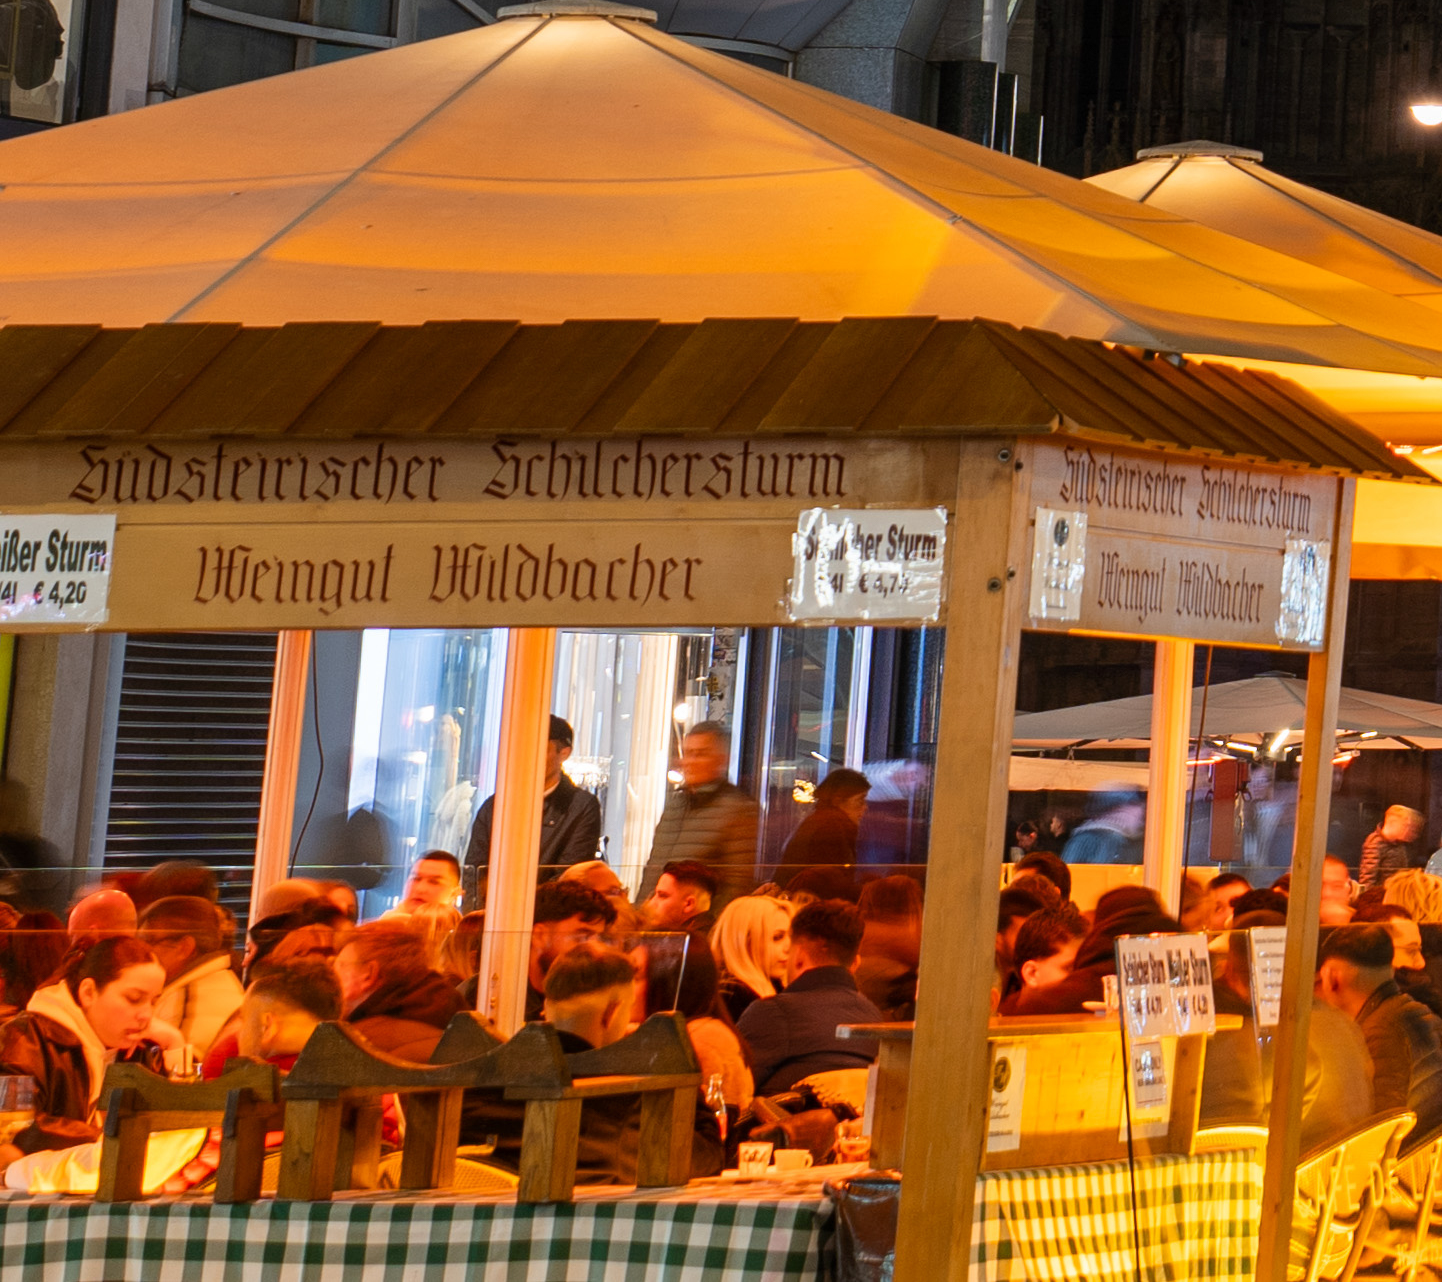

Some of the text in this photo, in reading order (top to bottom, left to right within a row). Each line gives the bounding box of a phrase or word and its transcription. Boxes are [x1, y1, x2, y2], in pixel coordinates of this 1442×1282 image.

[69, 437, 848, 504] Südsteirischer Schilchersturm
[0, 529, 107, 572] ißer Sturm
[886, 523, 937, 560] Sturm
[49, 580, 86, 609] 4,20
[194, 542, 703, 615] Weingut Wildbacher
[1098, 550, 1167, 624] Weingut
[1176, 559, 1264, 624] Wildbacher
